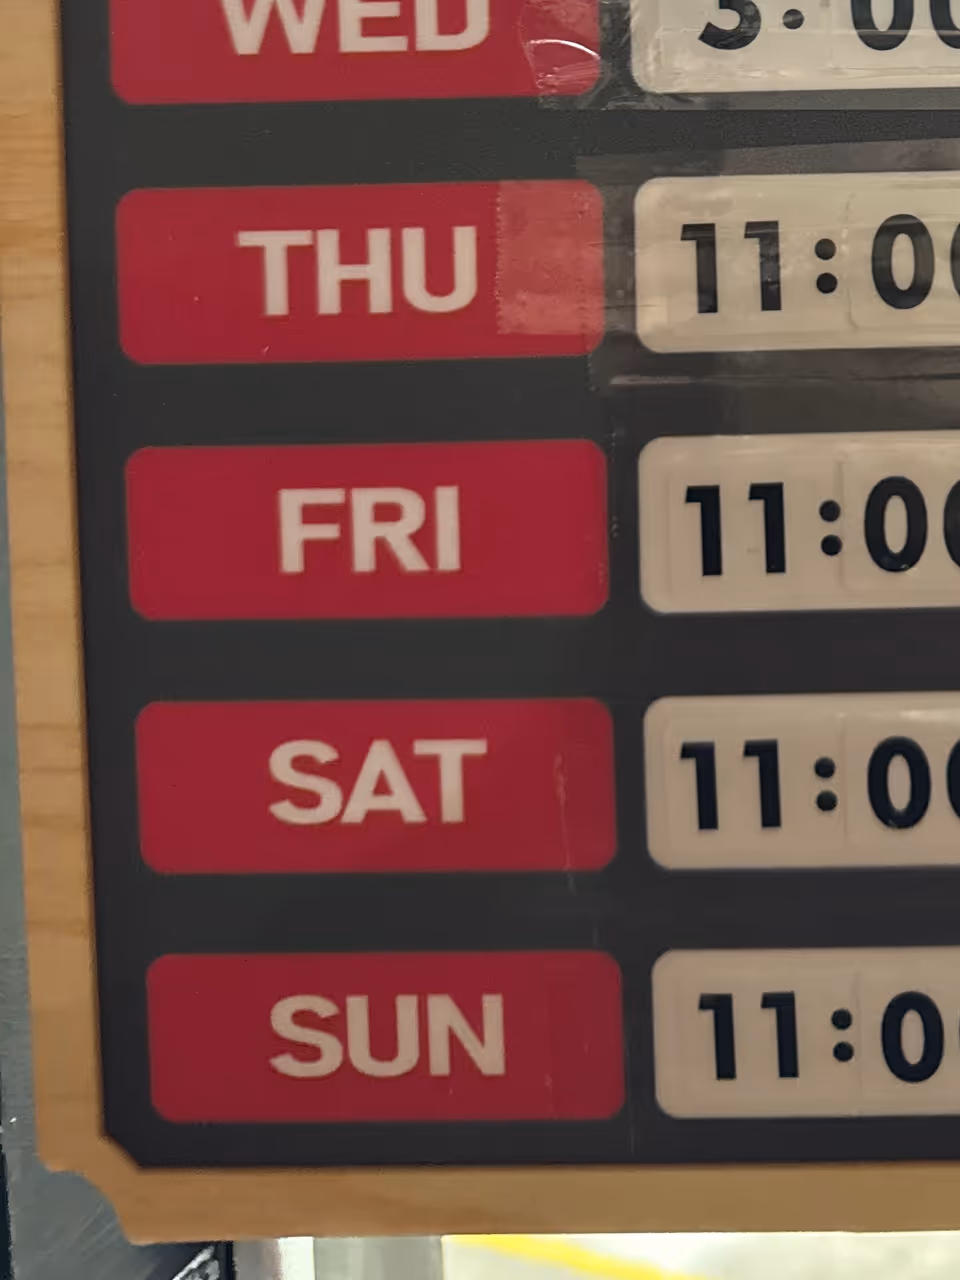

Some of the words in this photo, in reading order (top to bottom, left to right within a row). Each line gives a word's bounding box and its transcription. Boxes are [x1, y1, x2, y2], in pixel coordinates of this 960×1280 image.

[235, 225, 478, 316] THU
[279, 485, 461, 574] FRI
[268, 739, 487, 825] SAT
[270, 994, 506, 1077] SUN
